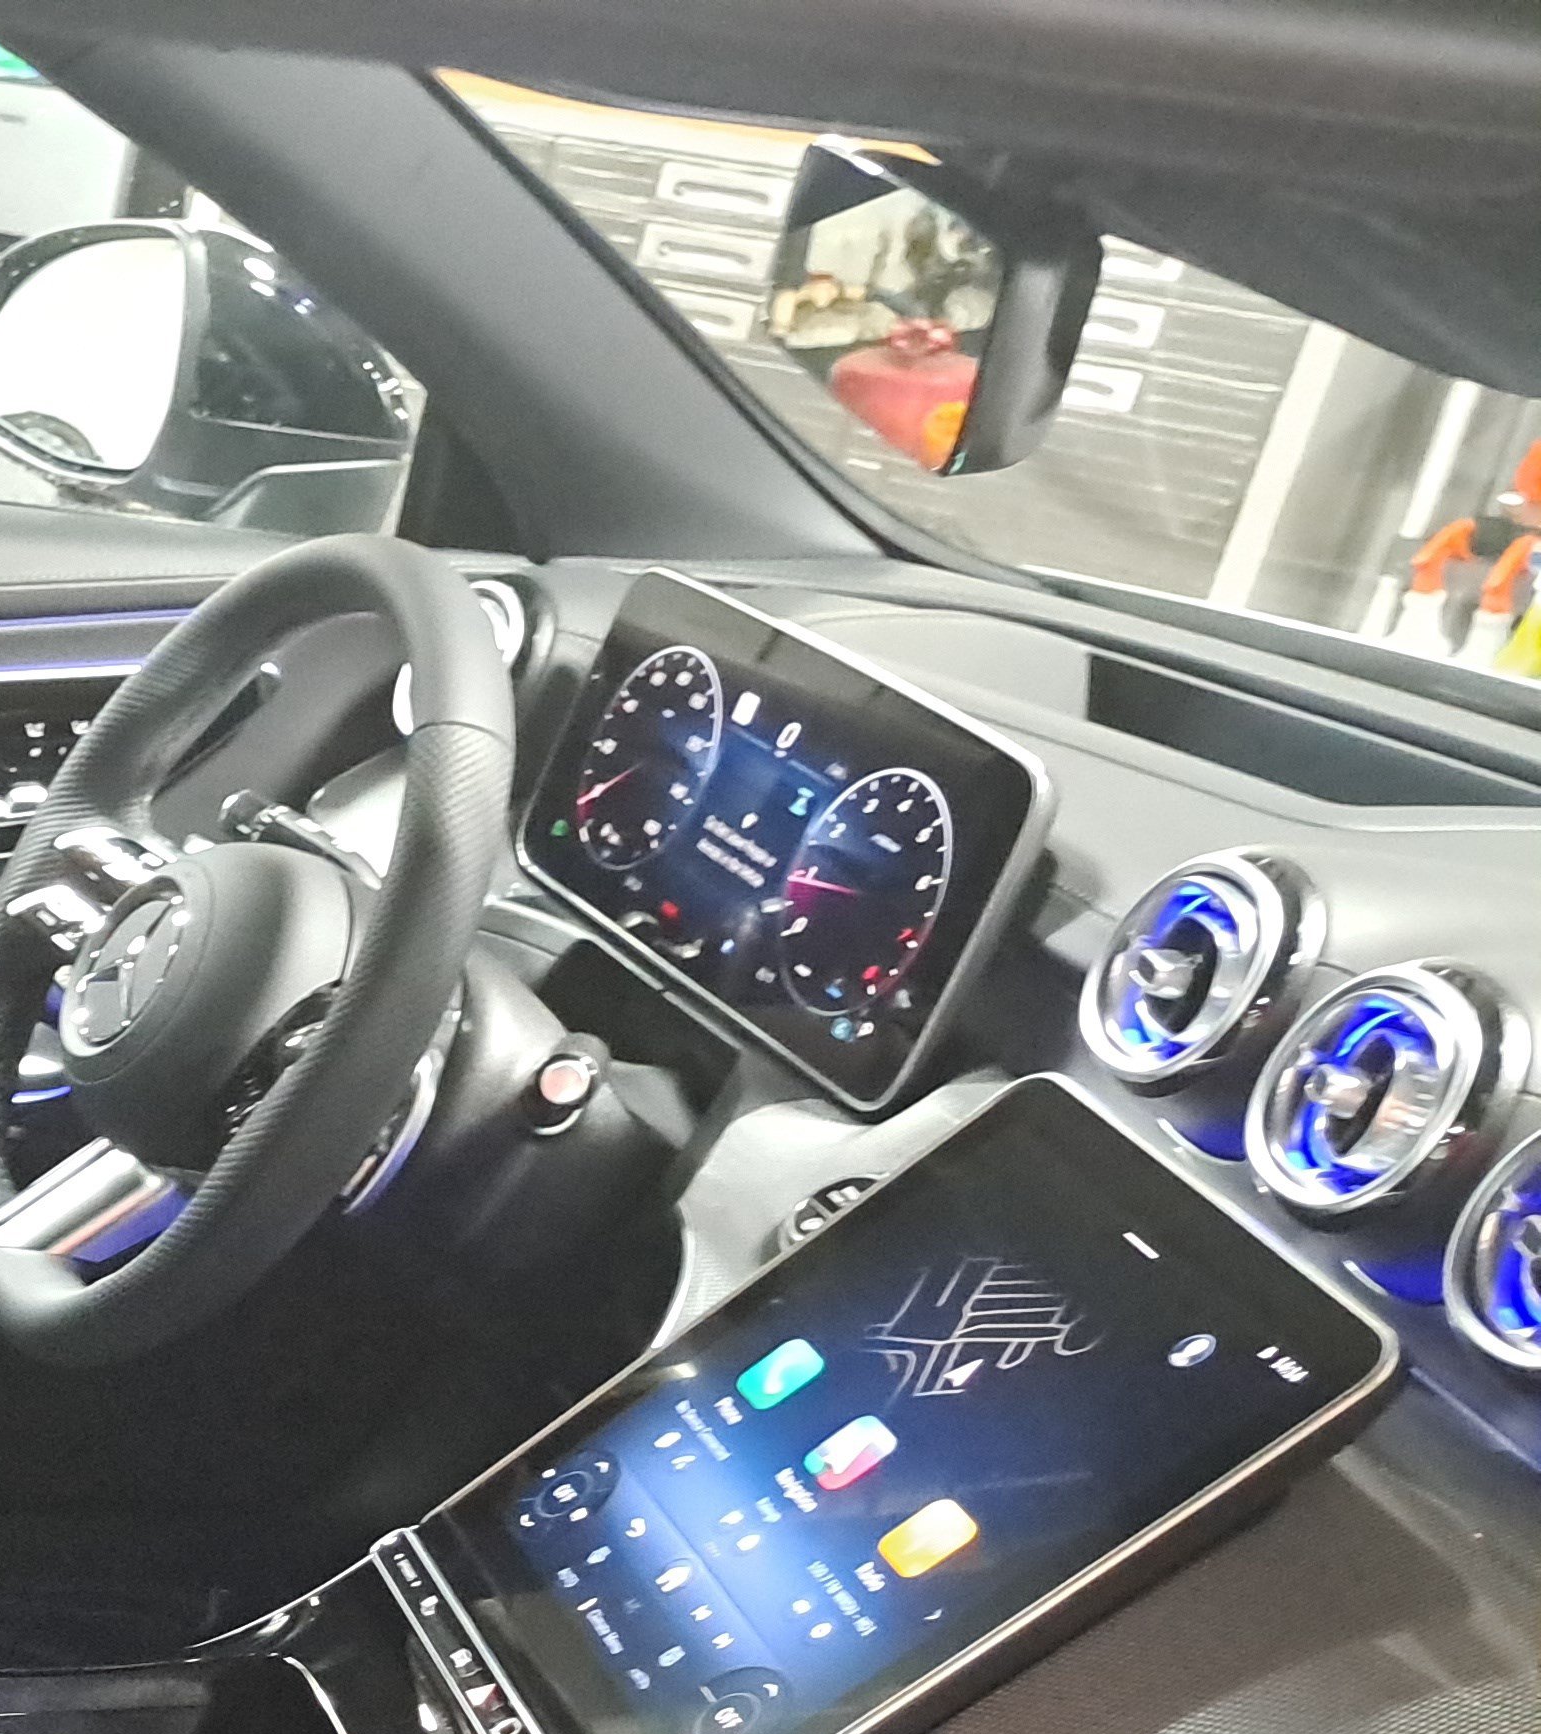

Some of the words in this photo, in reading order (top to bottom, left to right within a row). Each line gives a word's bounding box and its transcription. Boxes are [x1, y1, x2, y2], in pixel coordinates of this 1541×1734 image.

[776, 722, 802, 749] 0
[829, 822, 847, 839] 2
[552, 1483, 578, 1503] OFF
[774, 1466, 819, 1513] Navigation
[854, 1561, 886, 1592] Radio
[714, 1706, 744, 1729] OFF
